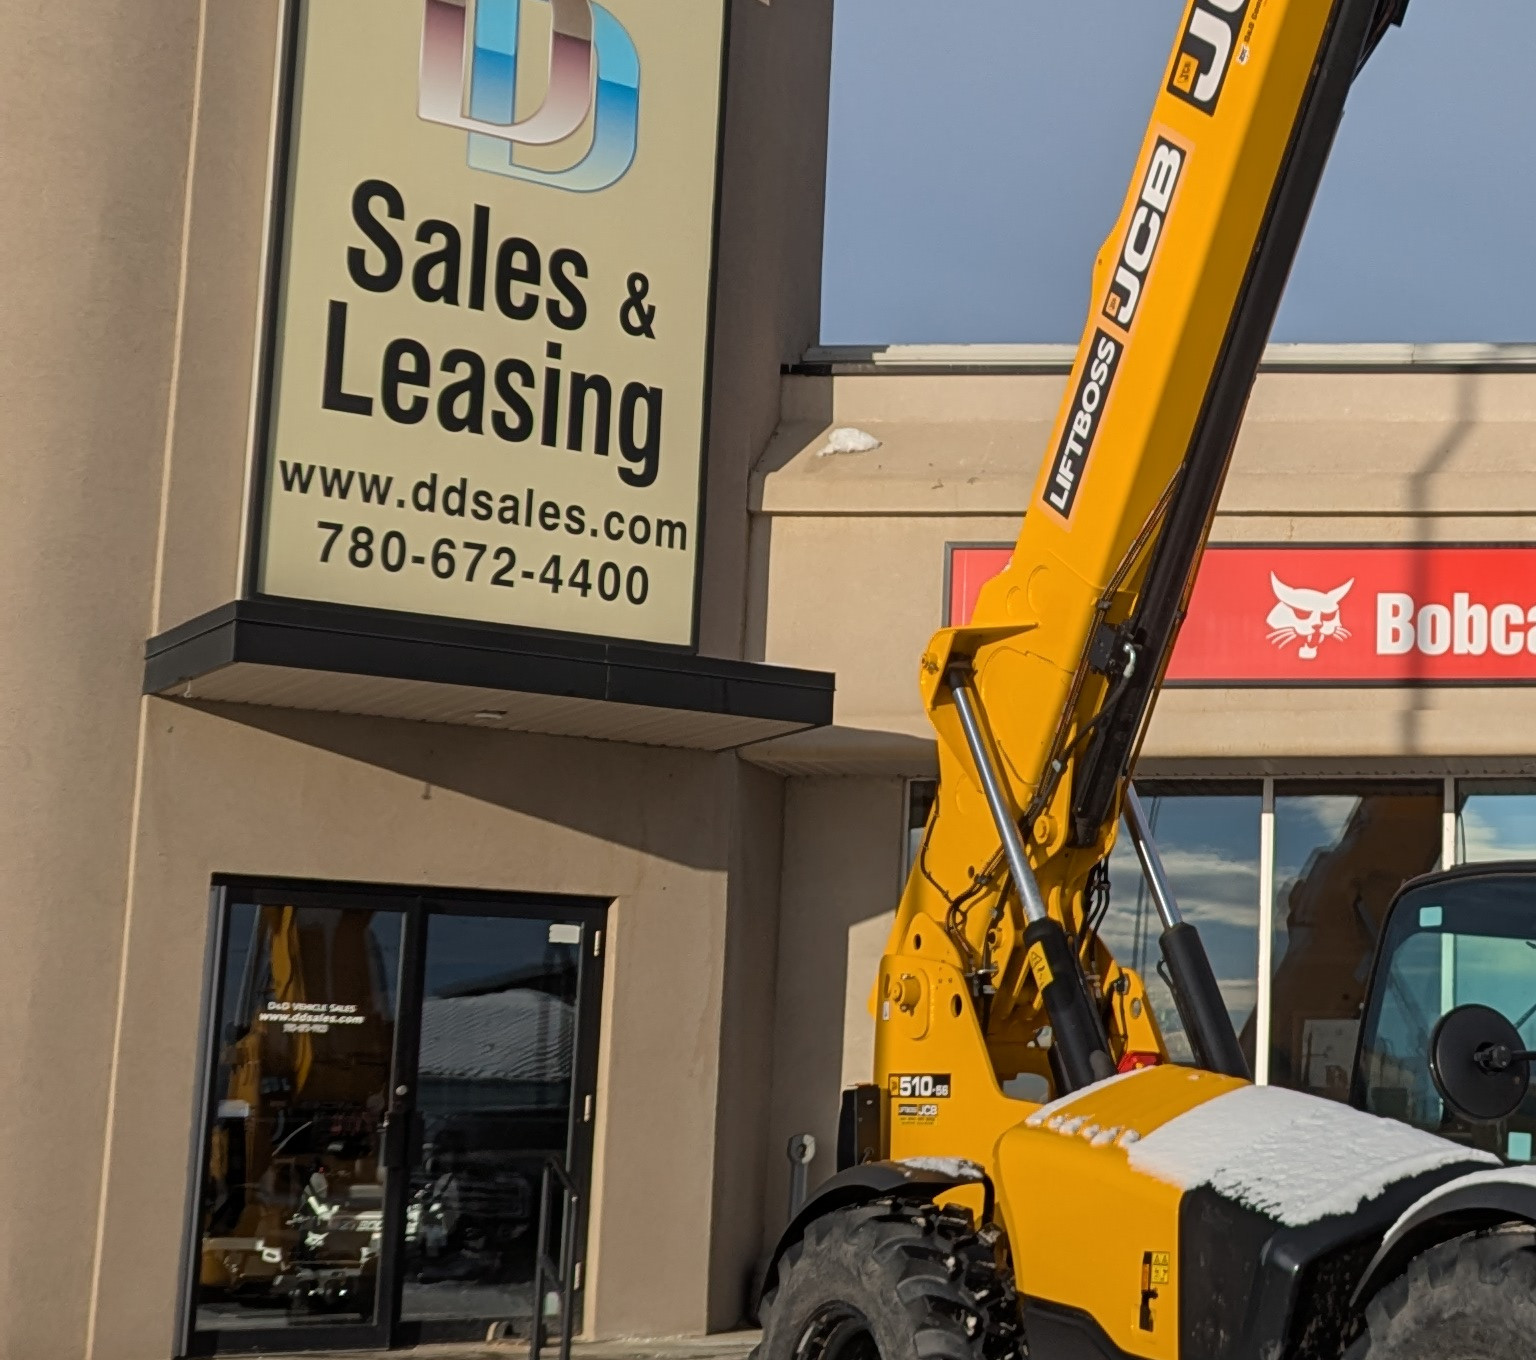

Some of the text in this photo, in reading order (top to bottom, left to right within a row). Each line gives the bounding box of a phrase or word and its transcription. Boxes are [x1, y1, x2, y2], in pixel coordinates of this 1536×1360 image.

[347, 179, 657, 340] Sales &
[1115, 144, 1182, 325] JCB
[322, 299, 664, 488] Leasing
[1049, 336, 1116, 510] LIFTBOSS
[278, 459, 688, 551] www.ddsales.com
[316, 520, 650, 605] 780-672-4400
[918, 1104, 938, 1116] JCB
